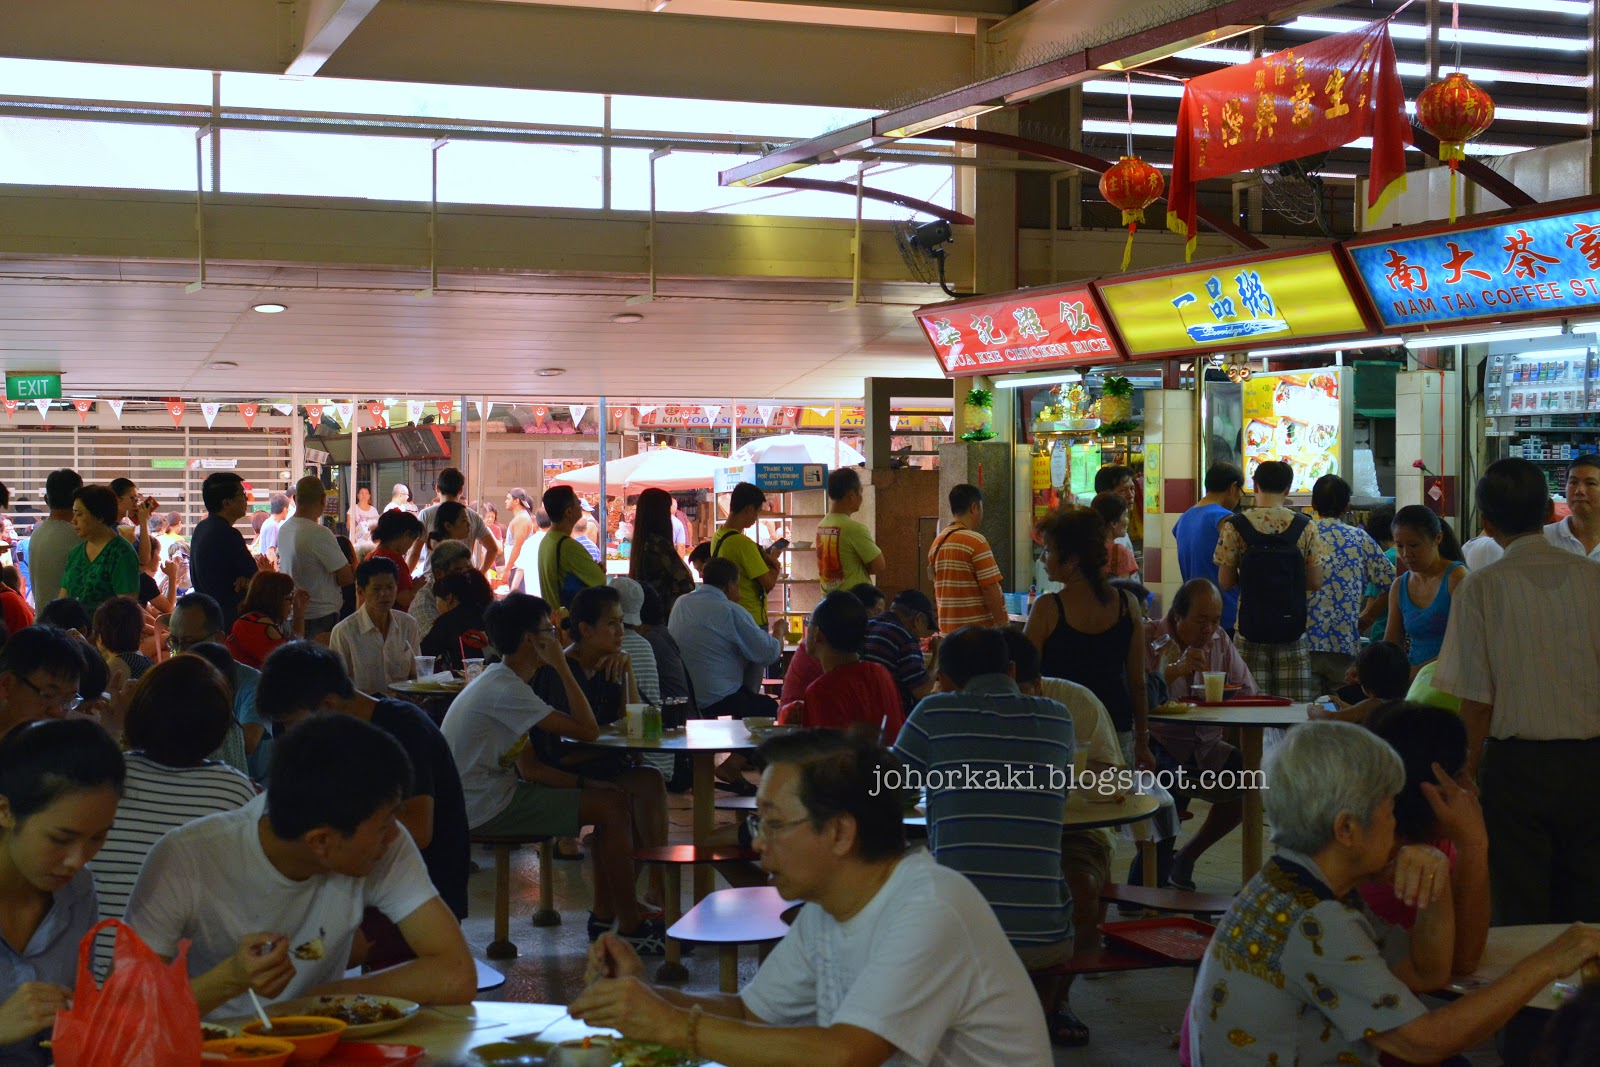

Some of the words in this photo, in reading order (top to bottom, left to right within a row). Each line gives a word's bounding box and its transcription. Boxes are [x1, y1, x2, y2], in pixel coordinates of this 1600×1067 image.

[1393, 296, 1438, 317] NAM
[1441, 291, 1477, 312] TAI
[1481, 281, 1565, 307] COFFEE
[975, 350, 1004, 364] KEE
[1004, 343, 1069, 361] CHICKEN
[1071, 338, 1111, 353] RICE
[17, 379, 49, 397] EXIT
[662, 416, 682, 424] KIM
